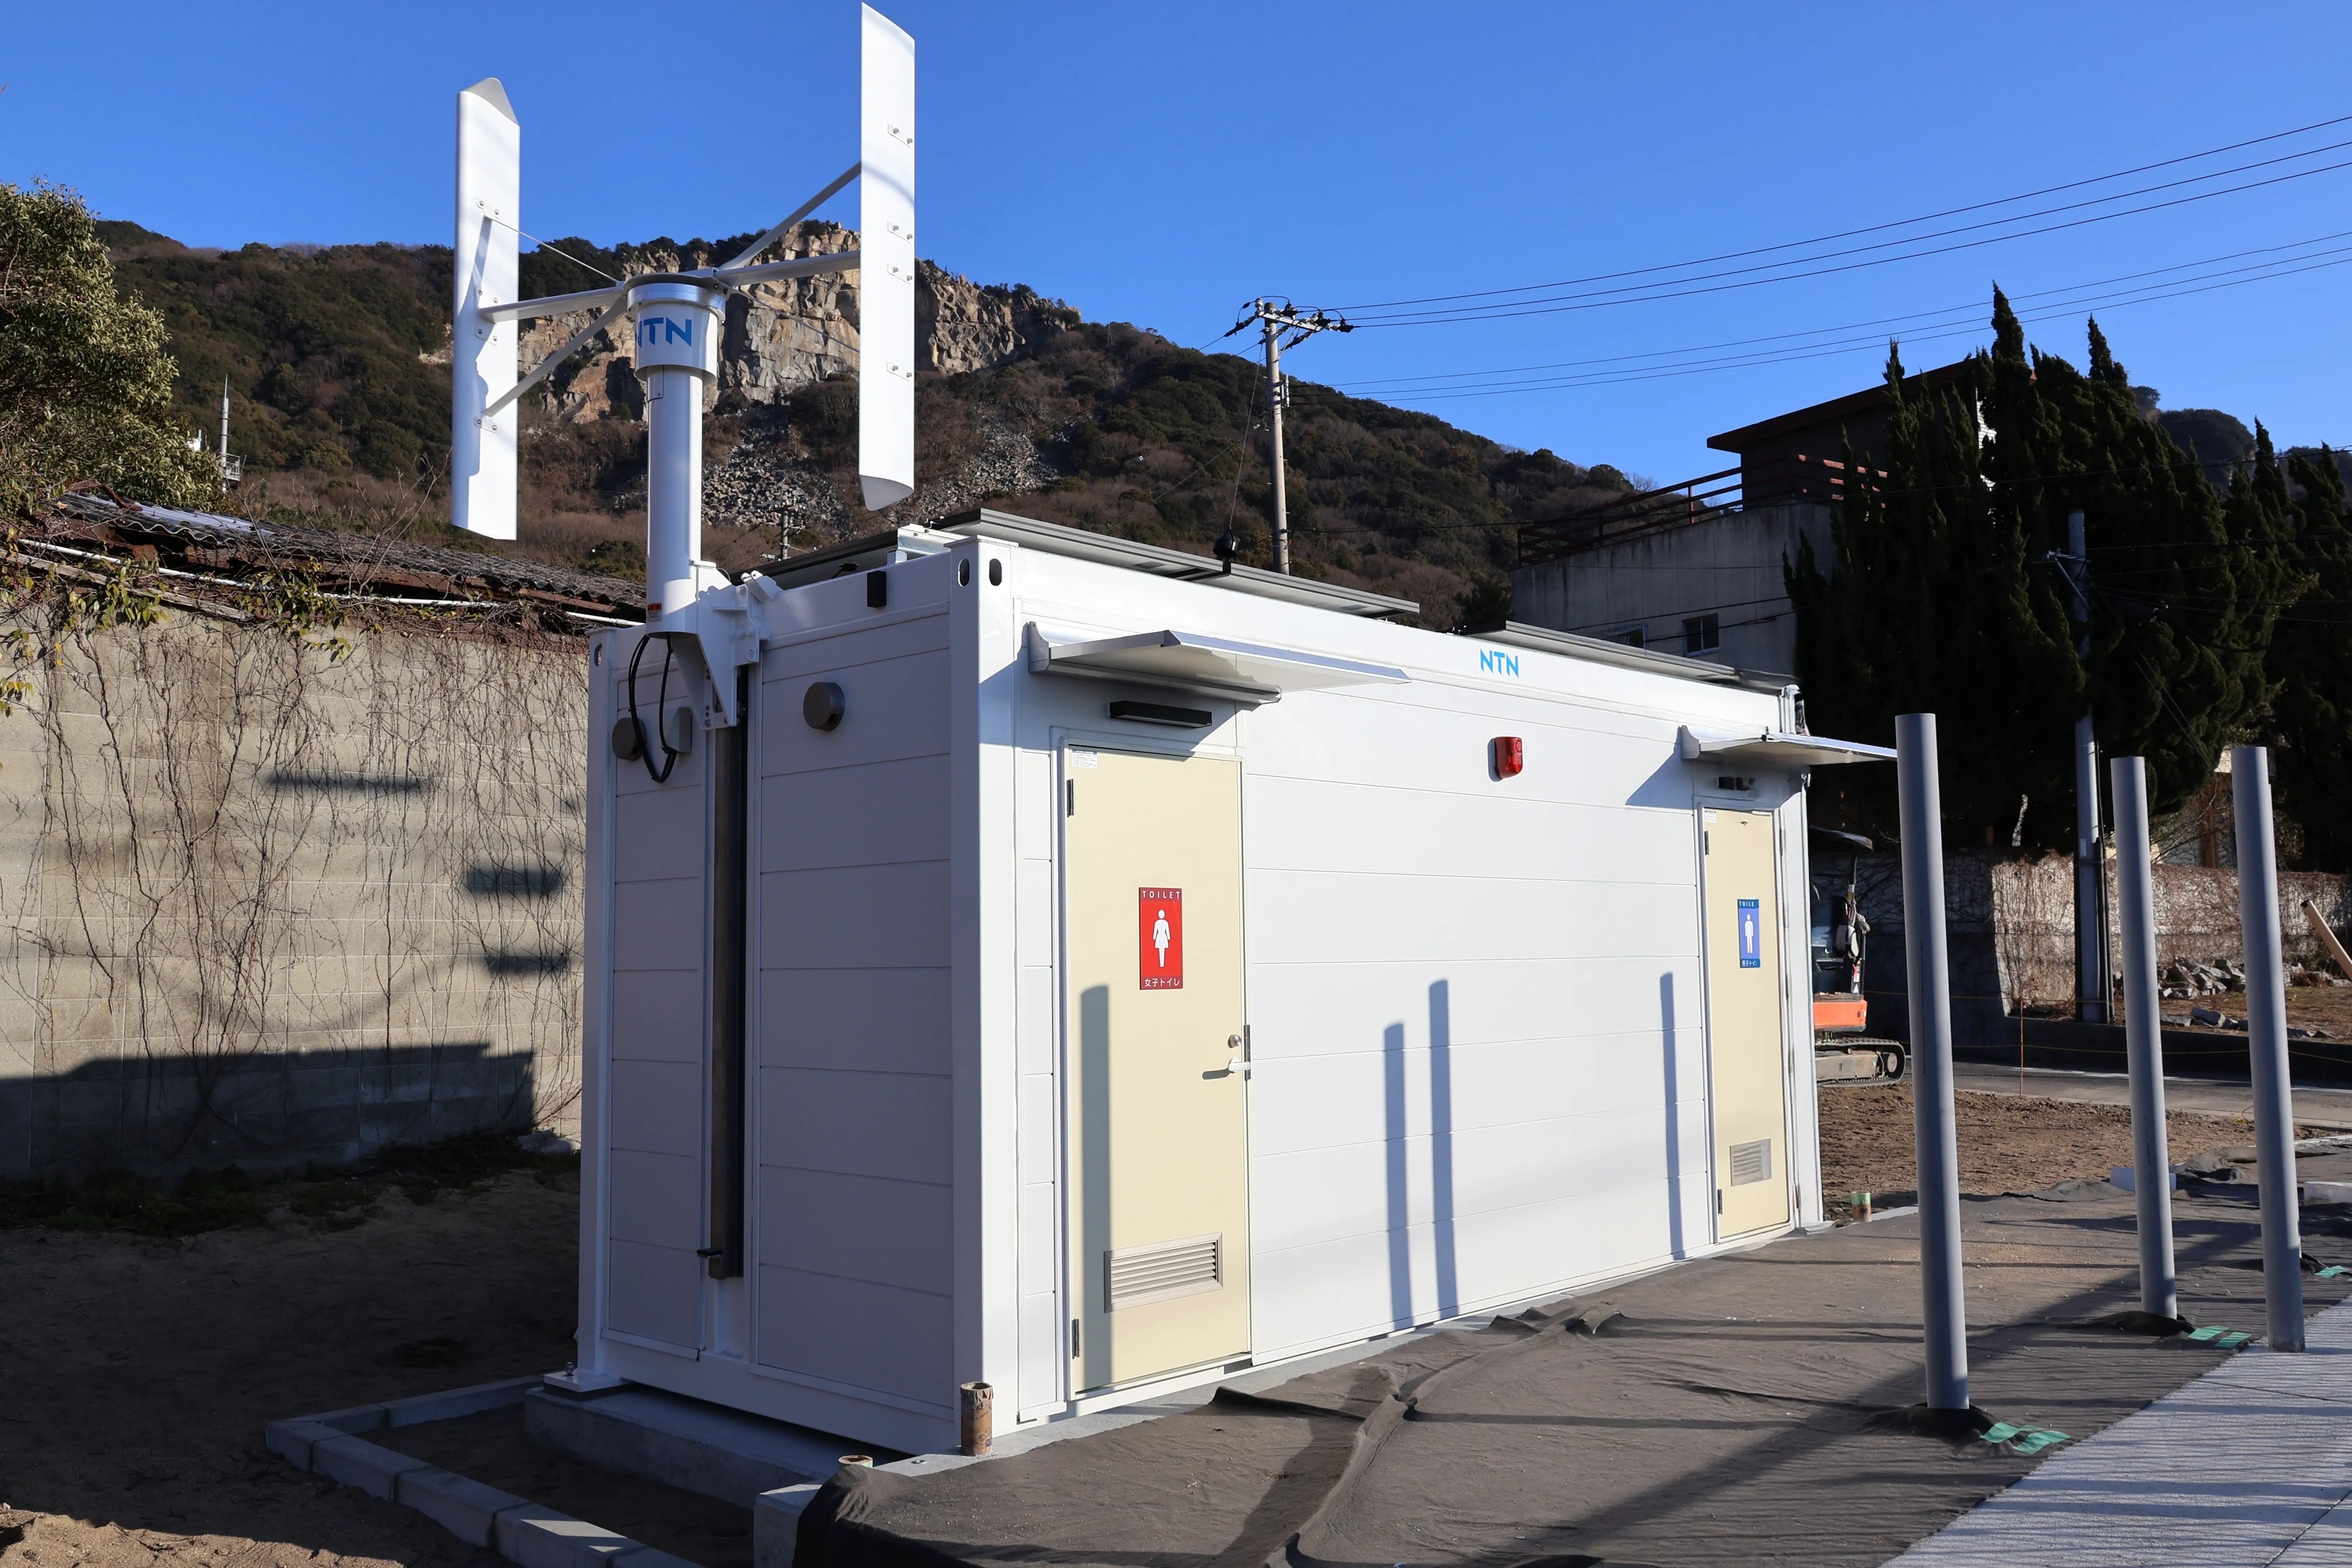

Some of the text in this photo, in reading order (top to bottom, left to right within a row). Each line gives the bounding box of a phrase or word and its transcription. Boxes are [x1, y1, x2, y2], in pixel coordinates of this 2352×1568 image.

[1480, 648, 1519, 679] NTN
[1142, 890, 1180, 899] TOILET
[1144, 978, 1180, 987] 女子トイレ
